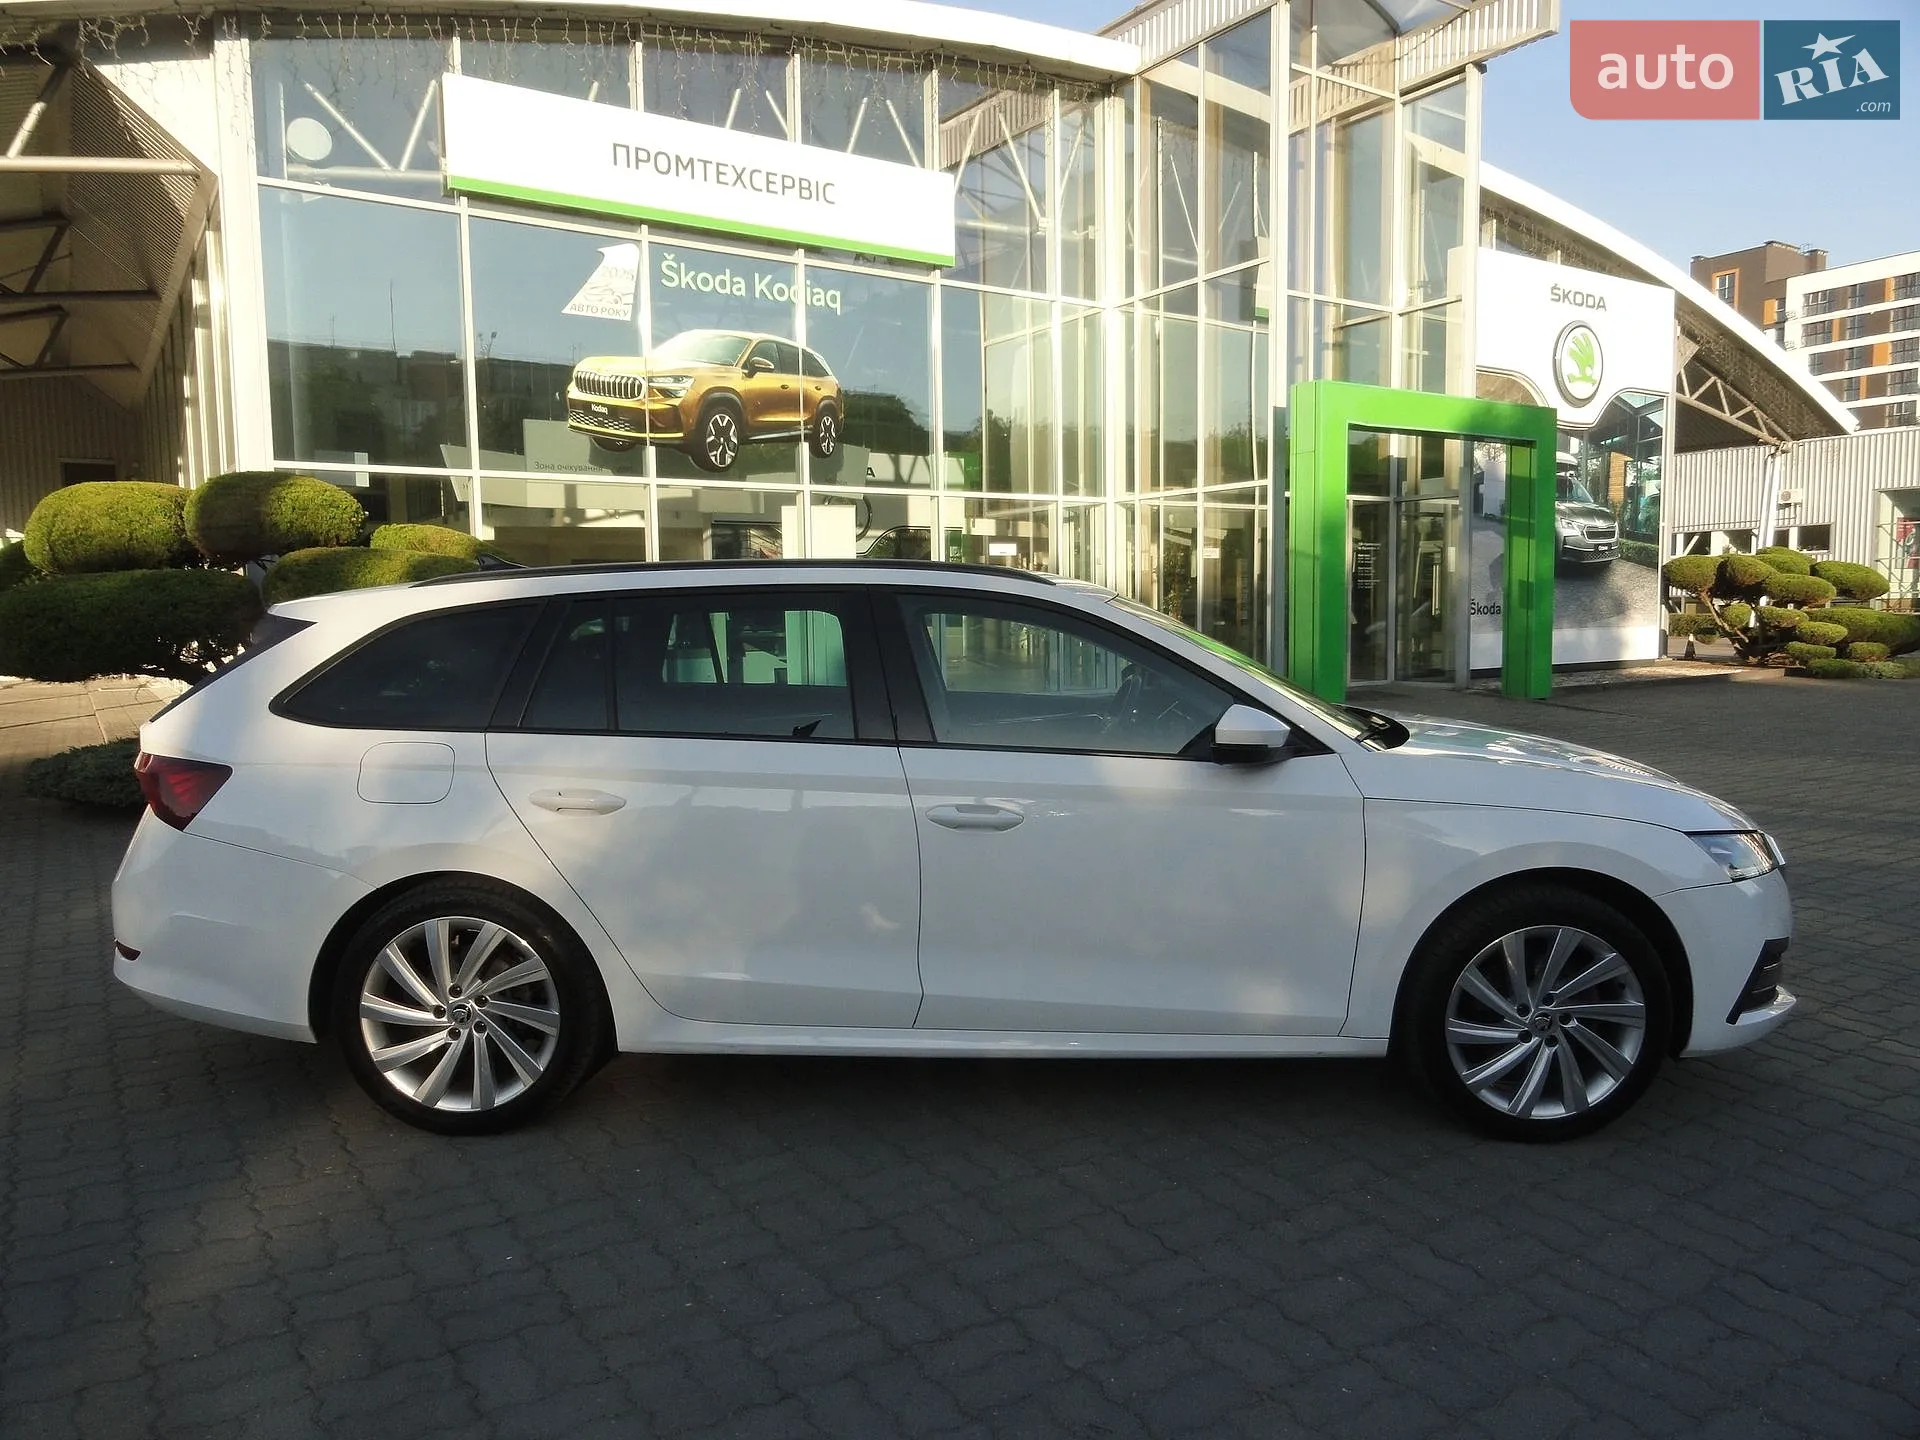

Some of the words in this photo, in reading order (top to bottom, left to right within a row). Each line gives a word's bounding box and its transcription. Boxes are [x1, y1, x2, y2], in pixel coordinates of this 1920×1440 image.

[612, 142, 835, 205] ПРОМТЕХСЕРВІС
[660, 252, 746, 297] Škoda
[569, 303, 599, 314] АВТО
[600, 306, 630, 318] РОКУ
[534, 461, 555, 471] Зона
